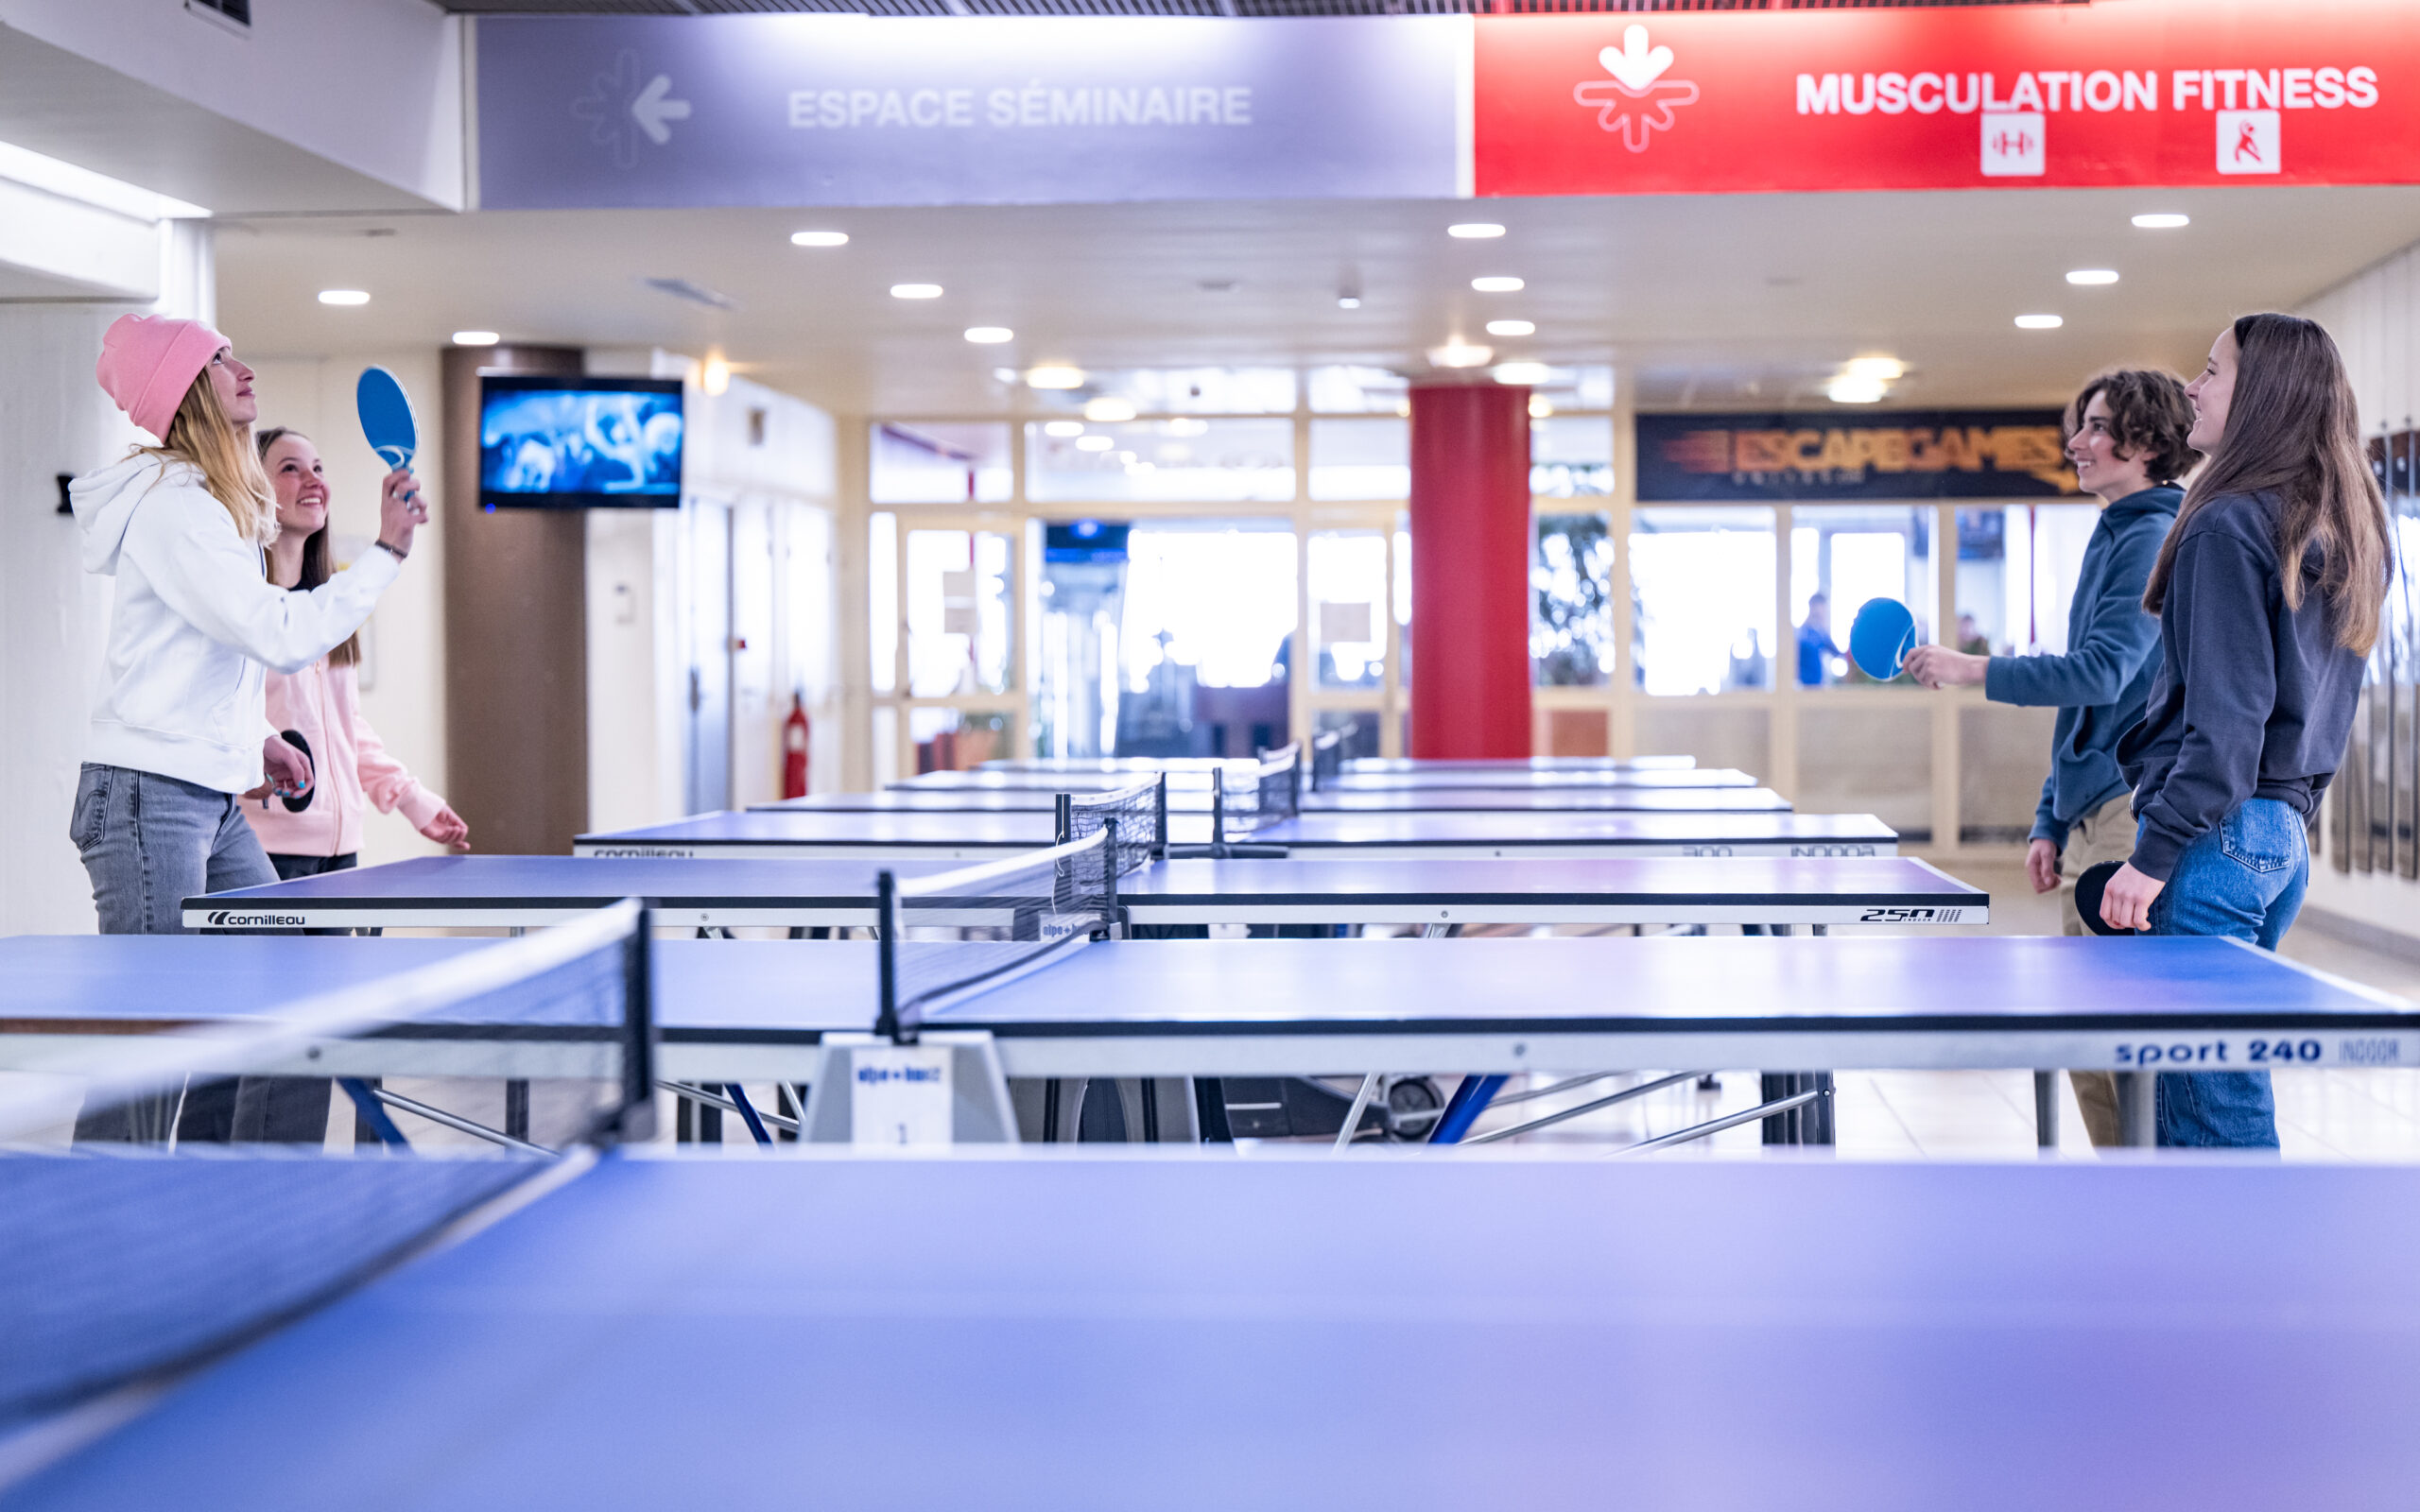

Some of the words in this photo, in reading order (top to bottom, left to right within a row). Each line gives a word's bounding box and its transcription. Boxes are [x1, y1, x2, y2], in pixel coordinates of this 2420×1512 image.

[788, 89, 974, 129] ESPACE
[986, 80, 1253, 128] SÉMINAIRE
[1797, 70, 2158, 115] MUSCULATION
[2172, 67, 2378, 111] FITNESS
[228, 915, 305, 925] cornilleau
[2115, 1040, 2229, 1066] sport
[2247, 1039, 2322, 1062] 240
